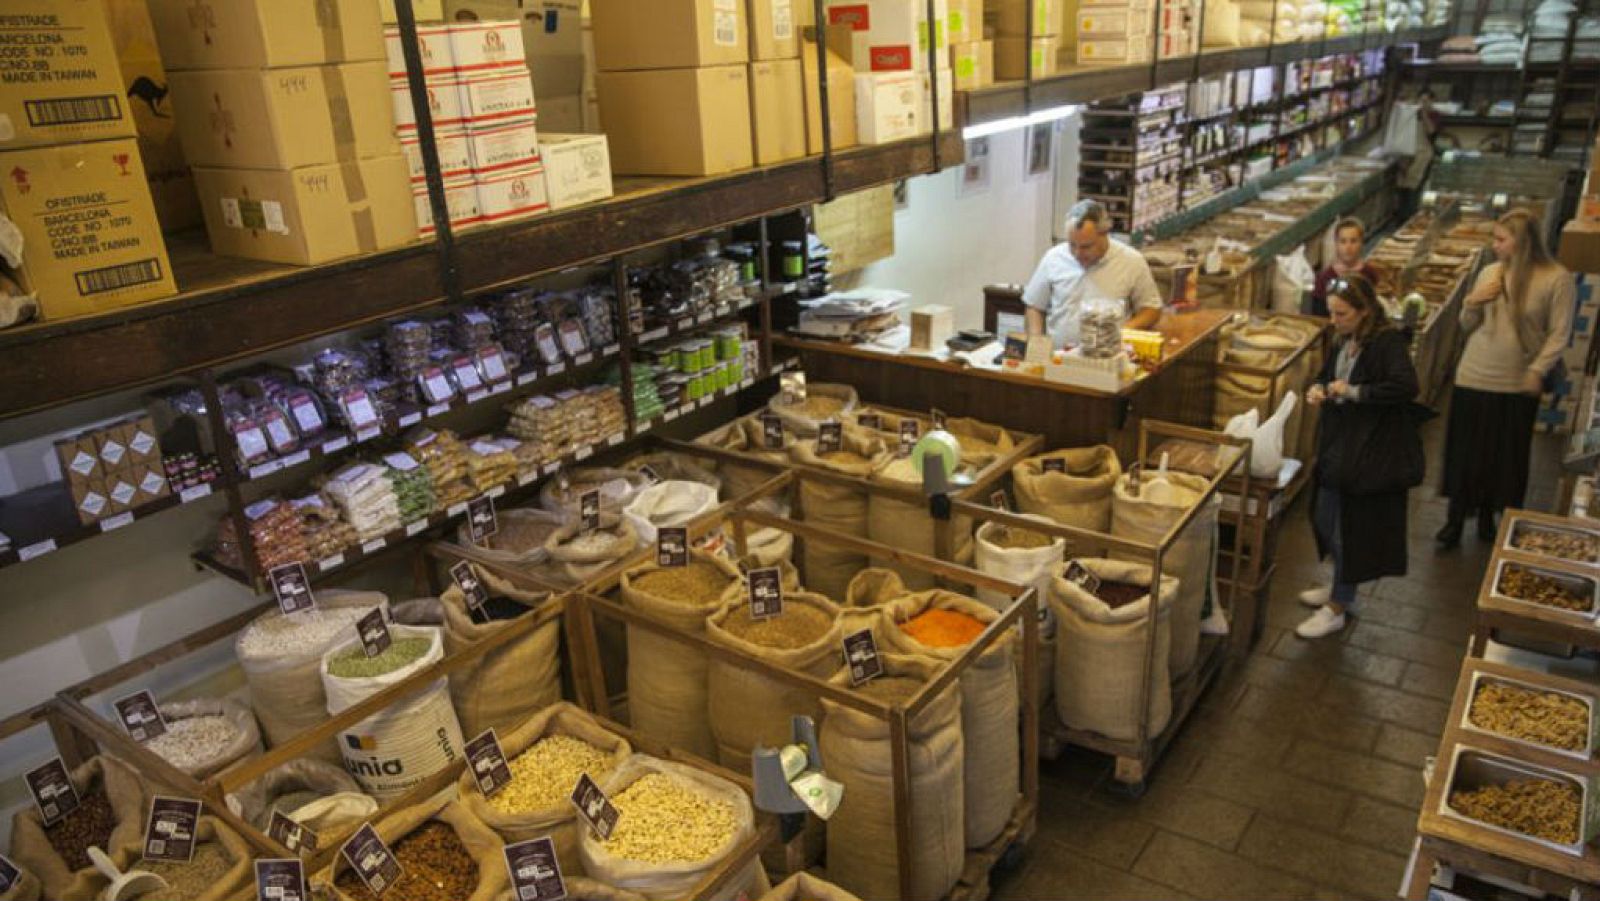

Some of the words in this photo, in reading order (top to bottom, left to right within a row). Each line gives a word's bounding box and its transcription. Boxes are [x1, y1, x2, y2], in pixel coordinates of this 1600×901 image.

[0, 34, 63, 45] ARCELONA
[2, 71, 36, 82] MADE
[40, 71, 52, 80] IN
[55, 69, 97, 80] TAIWAN
[45, 192, 107, 210] OFISTRADE
[44, 209, 111, 227] BARCELONA
[48, 224, 80, 238] CODE
[54, 248, 85, 259] MADE
[103, 237, 140, 250] TAIWAN
